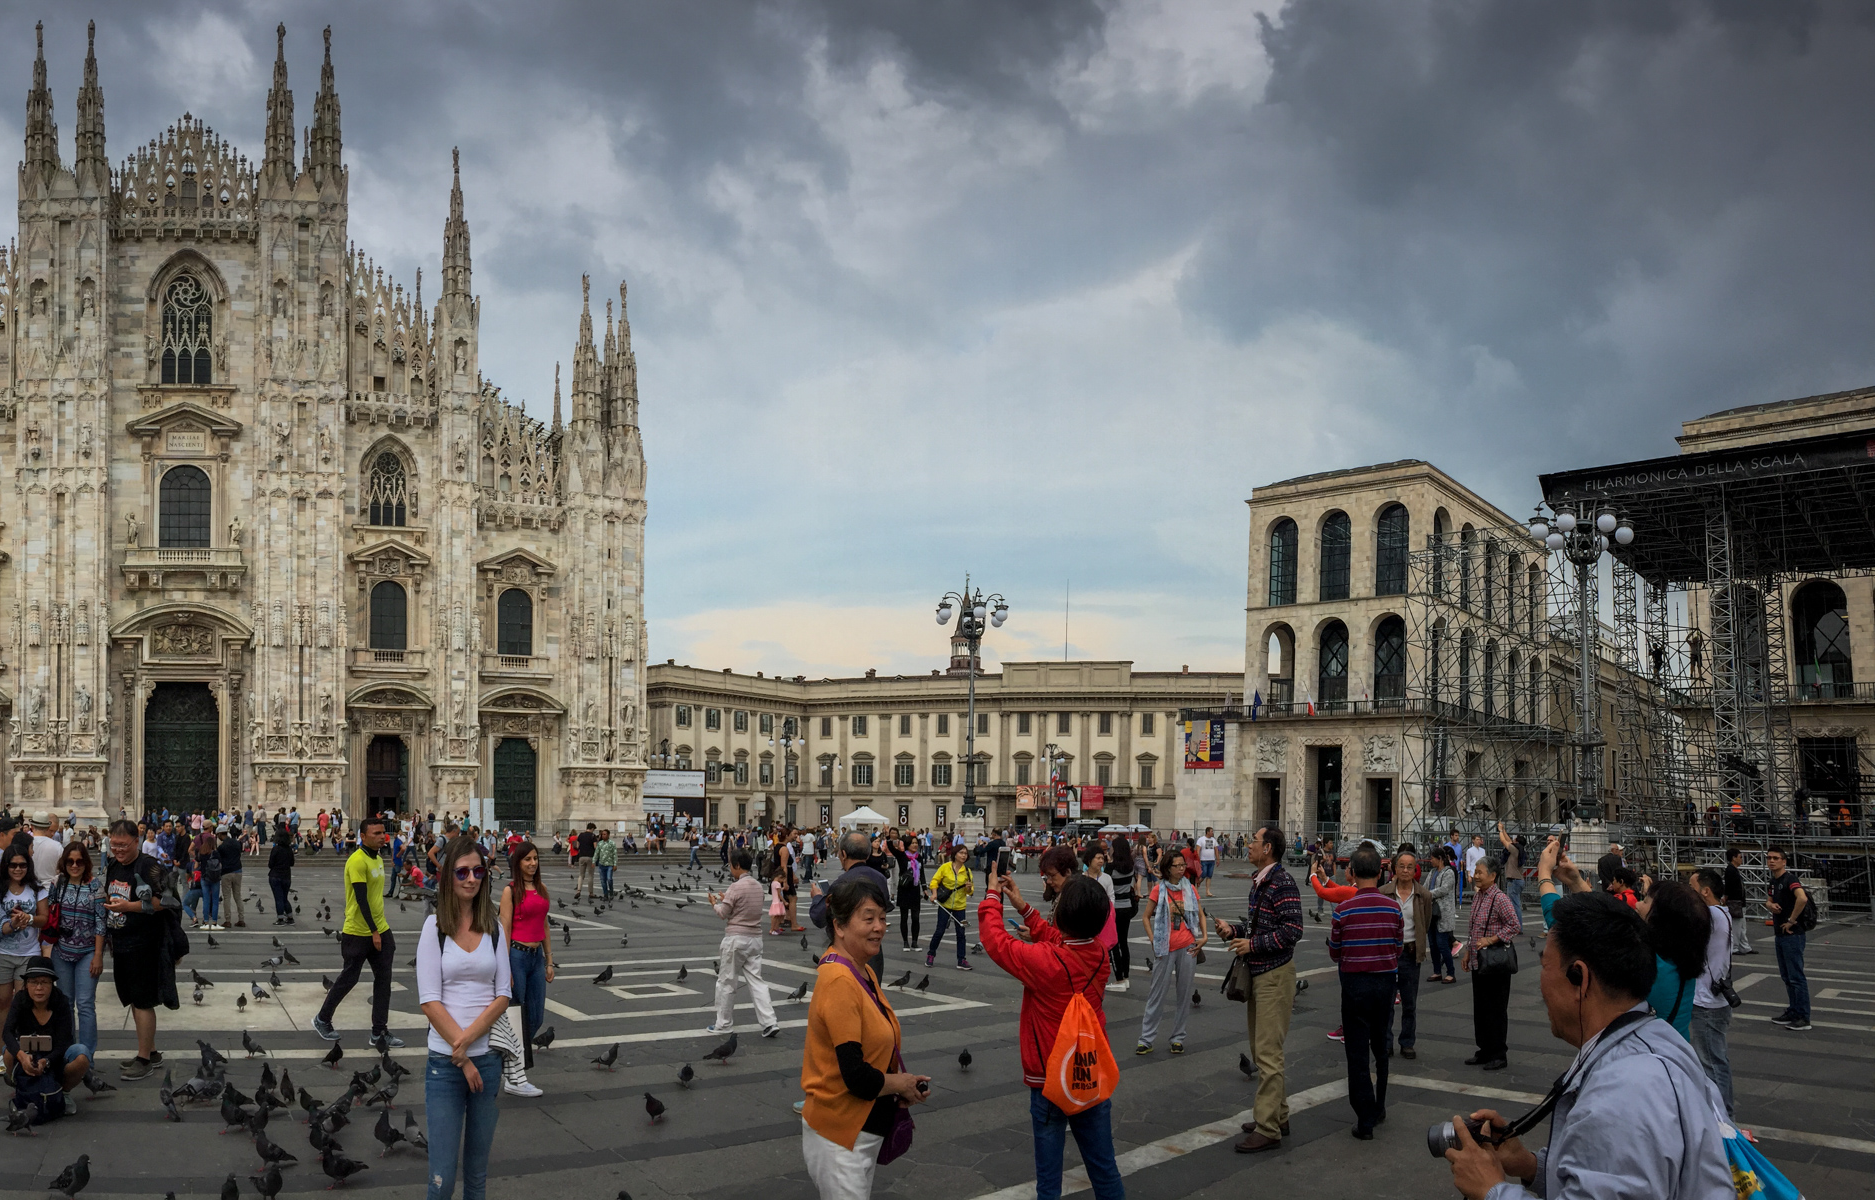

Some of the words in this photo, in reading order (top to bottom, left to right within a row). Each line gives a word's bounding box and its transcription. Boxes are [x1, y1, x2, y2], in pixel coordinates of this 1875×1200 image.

[1585, 468, 1688, 491] FILARMONICA
[1695, 460, 1745, 477] DELLA
[1751, 452, 1804, 470] SCALA
